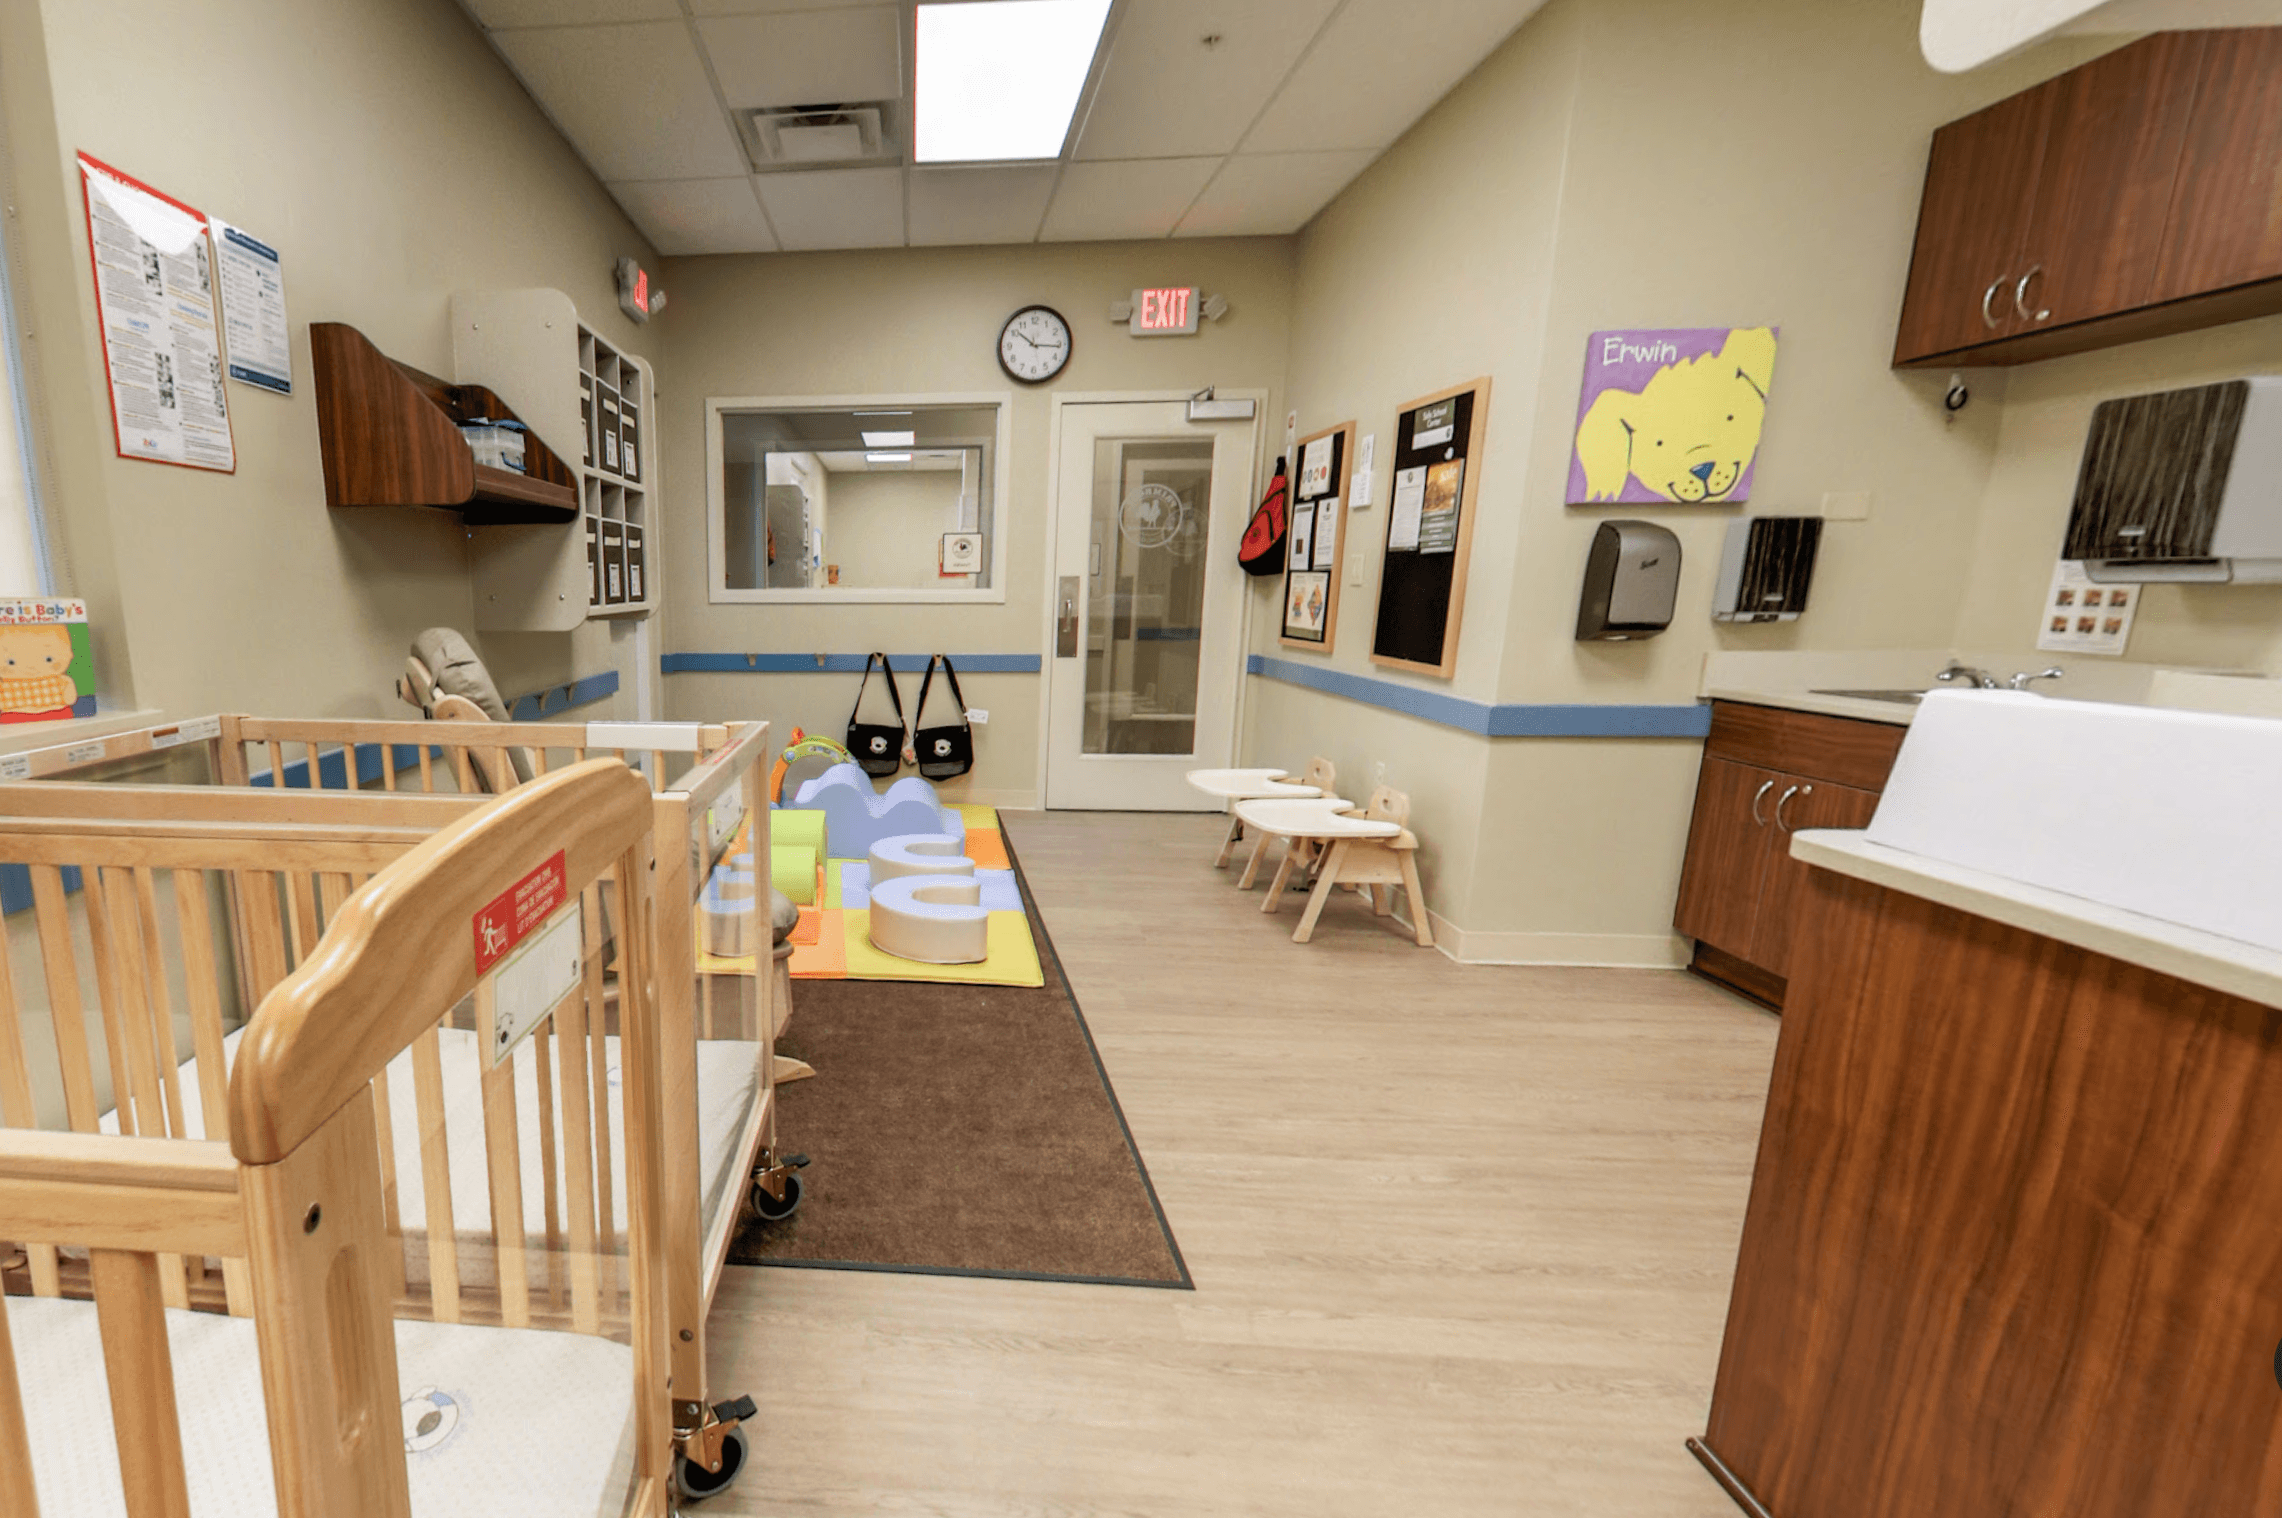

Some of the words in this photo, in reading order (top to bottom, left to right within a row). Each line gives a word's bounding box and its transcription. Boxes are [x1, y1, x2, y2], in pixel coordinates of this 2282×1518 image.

[1140, 287, 1191, 329] EXIT
[1020, 321, 1027, 329] 11
[1031, 316, 1040, 325] 12
[1052, 327, 1059, 336] 2
[1006, 342, 1013, 351] 9
[1602, 336, 1677, 366] Erwin
[1010, 354, 1016, 363] 8
[1052, 352, 1058, 361] 4
[1020, 363, 1025, 371] 7
[1030, 366, 1037, 374] 6
[1043, 362, 1049, 371] 5
[35, 603, 83, 618] Baby's
